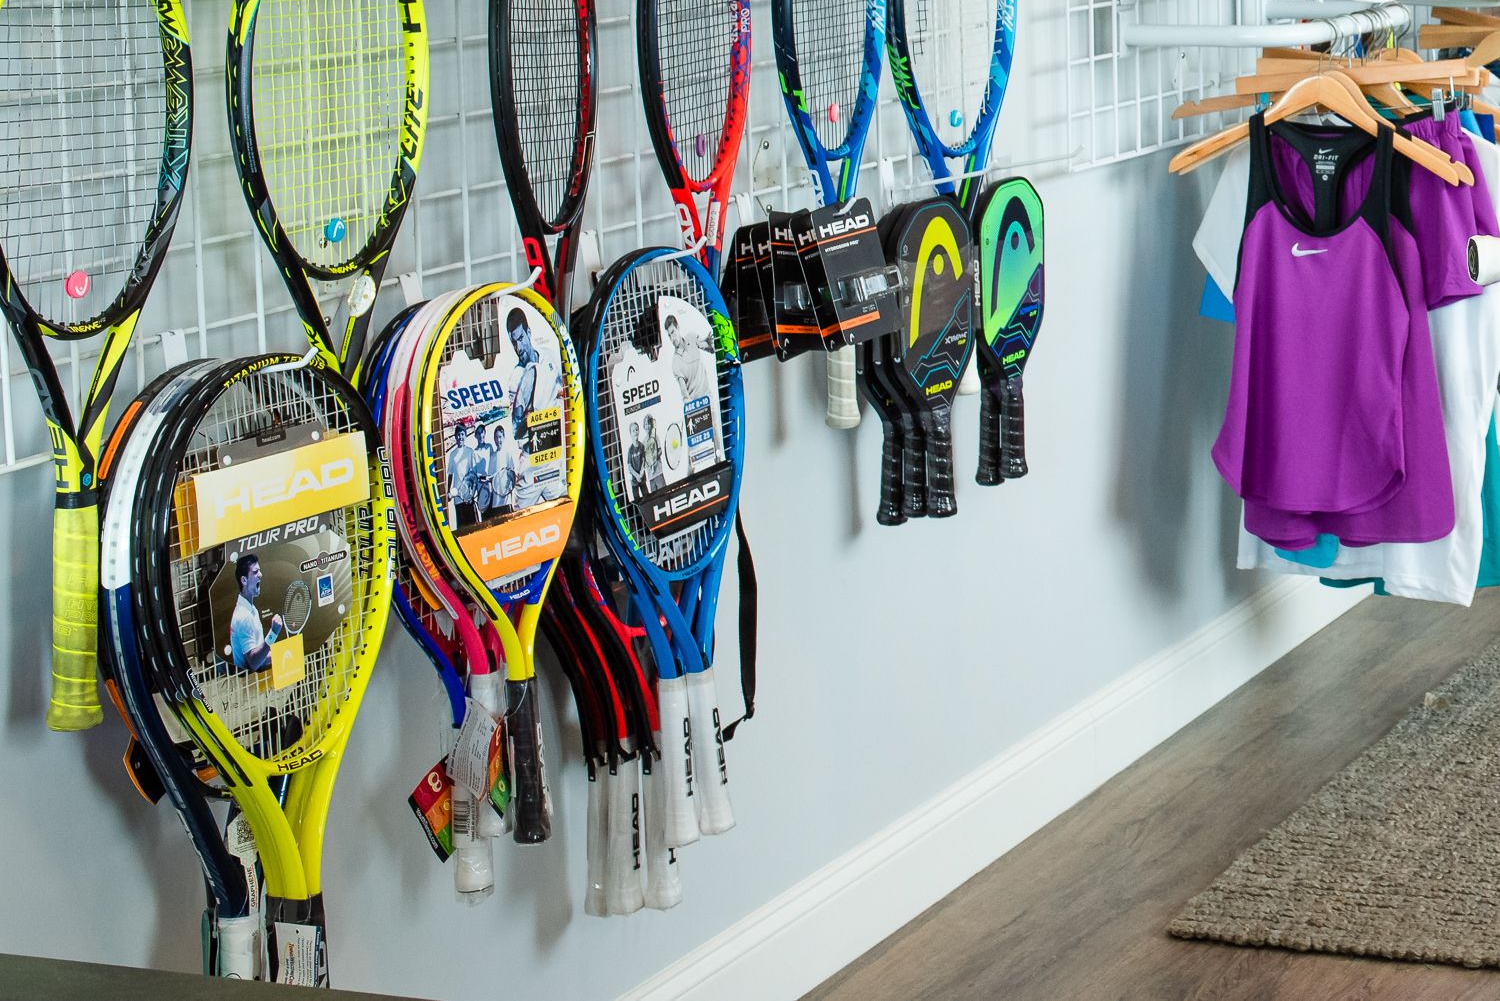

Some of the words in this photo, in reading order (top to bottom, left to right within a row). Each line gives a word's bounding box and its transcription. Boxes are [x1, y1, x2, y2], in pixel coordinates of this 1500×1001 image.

[741, 8, 750, 32] PRO
[819, 214, 869, 238] HEAD
[1003, 349, 1025, 364] HEAD
[223, 356, 280, 389] TITANIUM
[447, 379, 504, 410] SPEED
[623, 380, 660, 405] SPEED
[926, 380, 952, 396] HEAD
[685, 402, 695, 411] AGE
[29, 368, 69, 489] HEAD
[530, 414, 543, 424] AGE
[691, 436, 703, 445] SIZE
[534, 453, 548, 463] SIZE
[550, 451, 557, 459] 21
[215, 457, 354, 519] HEAD
[427, 434, 447, 527] HEAD
[653, 480, 720, 521] HEAD
[238, 528, 280, 552] TOUR
[284, 515, 319, 539] PRO
[480, 523, 561, 564] HEAD
[303, 559, 318, 570] NANO
[320, 552, 344, 564] TITANIUM
[320, 589, 333, 598] ATP
[509, 588, 531, 600] HEAD
[683, 717, 694, 797] HEAD
[713, 707, 727, 785] HEAD
[278, 749, 322, 772] HEAD
[631, 793, 640, 871] HEAD
